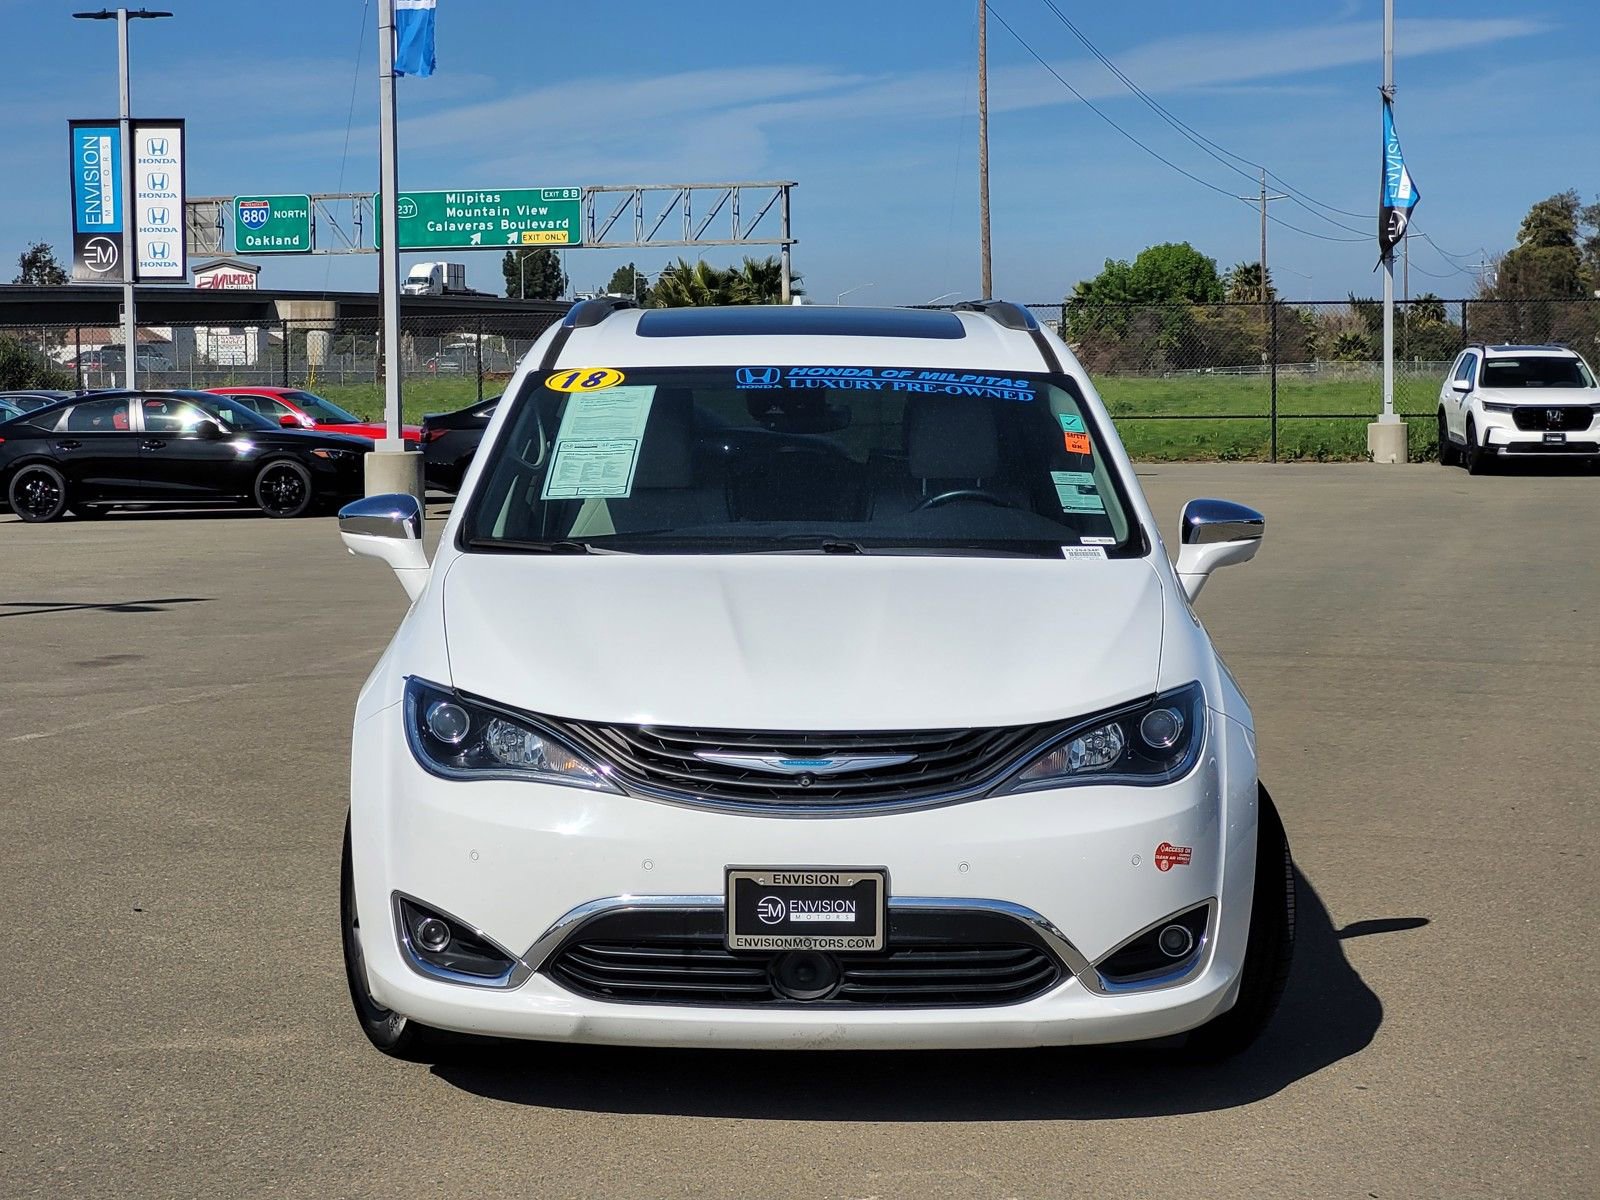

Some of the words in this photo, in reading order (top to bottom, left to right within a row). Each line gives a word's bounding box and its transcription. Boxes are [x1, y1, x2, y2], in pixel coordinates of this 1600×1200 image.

[83, 136, 101, 224] ENVISION
[103, 145, 111, 216] MOTORS
[446, 193, 501, 205] Milpitas
[398, 205, 413, 214] 237
[446, 206, 510, 218] Mountain
[517, 205, 548, 216] View
[243, 209, 267, 223] 880
[274, 210, 307, 219] NORTH
[427, 220, 494, 232] Calaveras
[501, 218, 569, 230] Boulevard
[245, 235, 300, 246] Oakland
[523, 233, 540, 241] EXIT
[545, 233, 567, 241] ONLY
[561, 371, 608, 389] 18
[788, 367, 876, 379] HONDA
[880, 369, 915, 379] OF
[921, 371, 1031, 389] MILPITAS
[790, 378, 888, 391] LUXURY
[893, 381, 1035, 401] PRE-OWNED
[1066, 432, 1087, 440] SAFETY
[773, 874, 839, 884] ENVISION
[789, 900, 856, 912] ENVISION
[736, 937, 875, 948] ENVISIONMOTORS.COM
